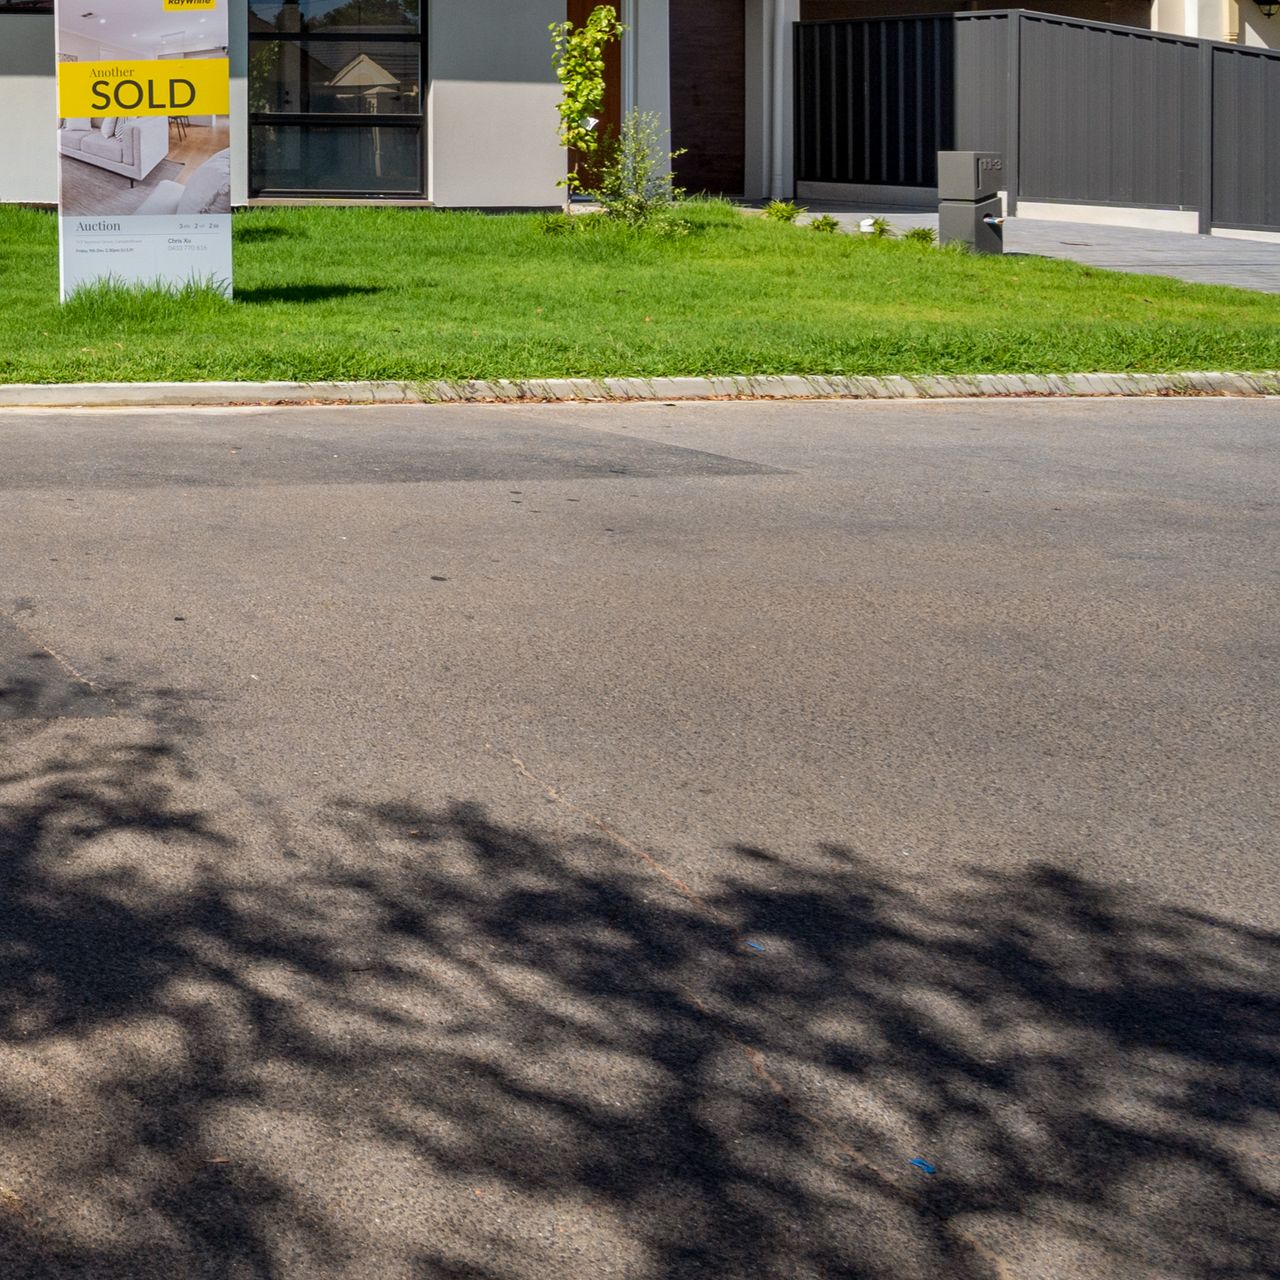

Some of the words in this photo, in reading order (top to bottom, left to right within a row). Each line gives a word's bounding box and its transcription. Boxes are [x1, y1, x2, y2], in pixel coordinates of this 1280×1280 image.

[89, 67, 134, 78] Another
[91, 79, 196, 110] SOLD
[76, 220, 121, 232] Auction
